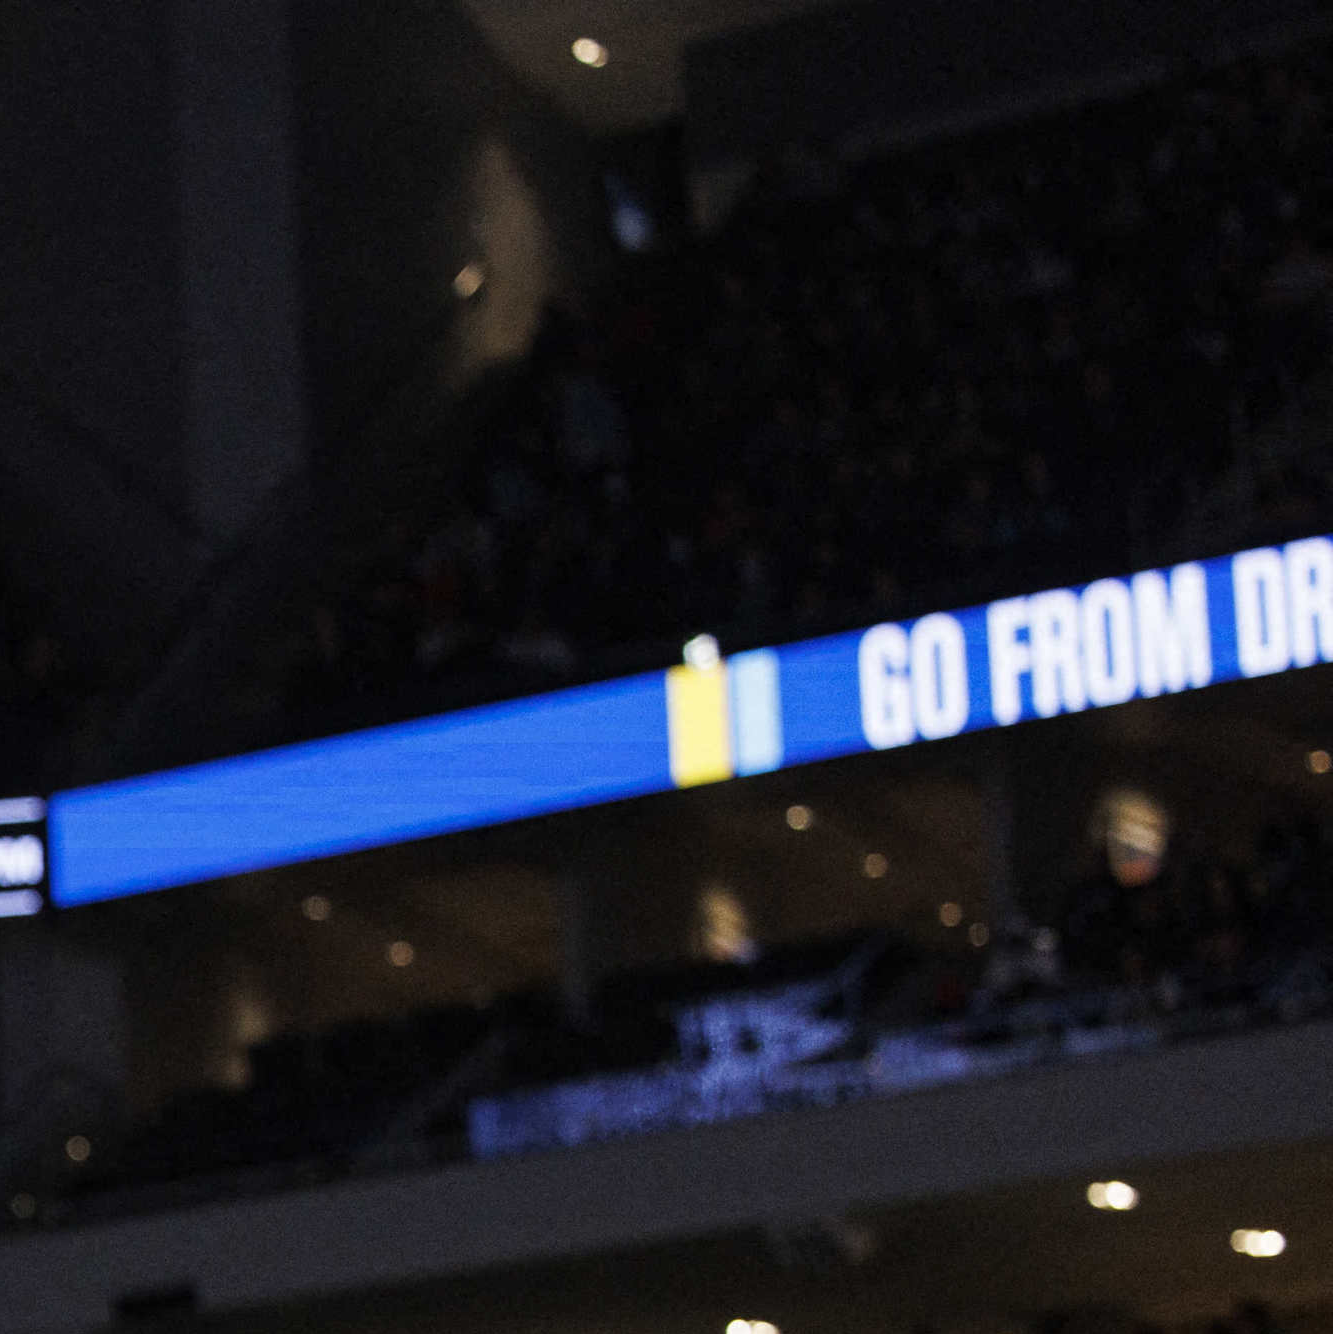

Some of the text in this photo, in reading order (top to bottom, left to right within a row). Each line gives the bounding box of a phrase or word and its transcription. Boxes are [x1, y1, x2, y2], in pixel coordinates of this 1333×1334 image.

[858, 535, 1333, 751] GO FROM DR
